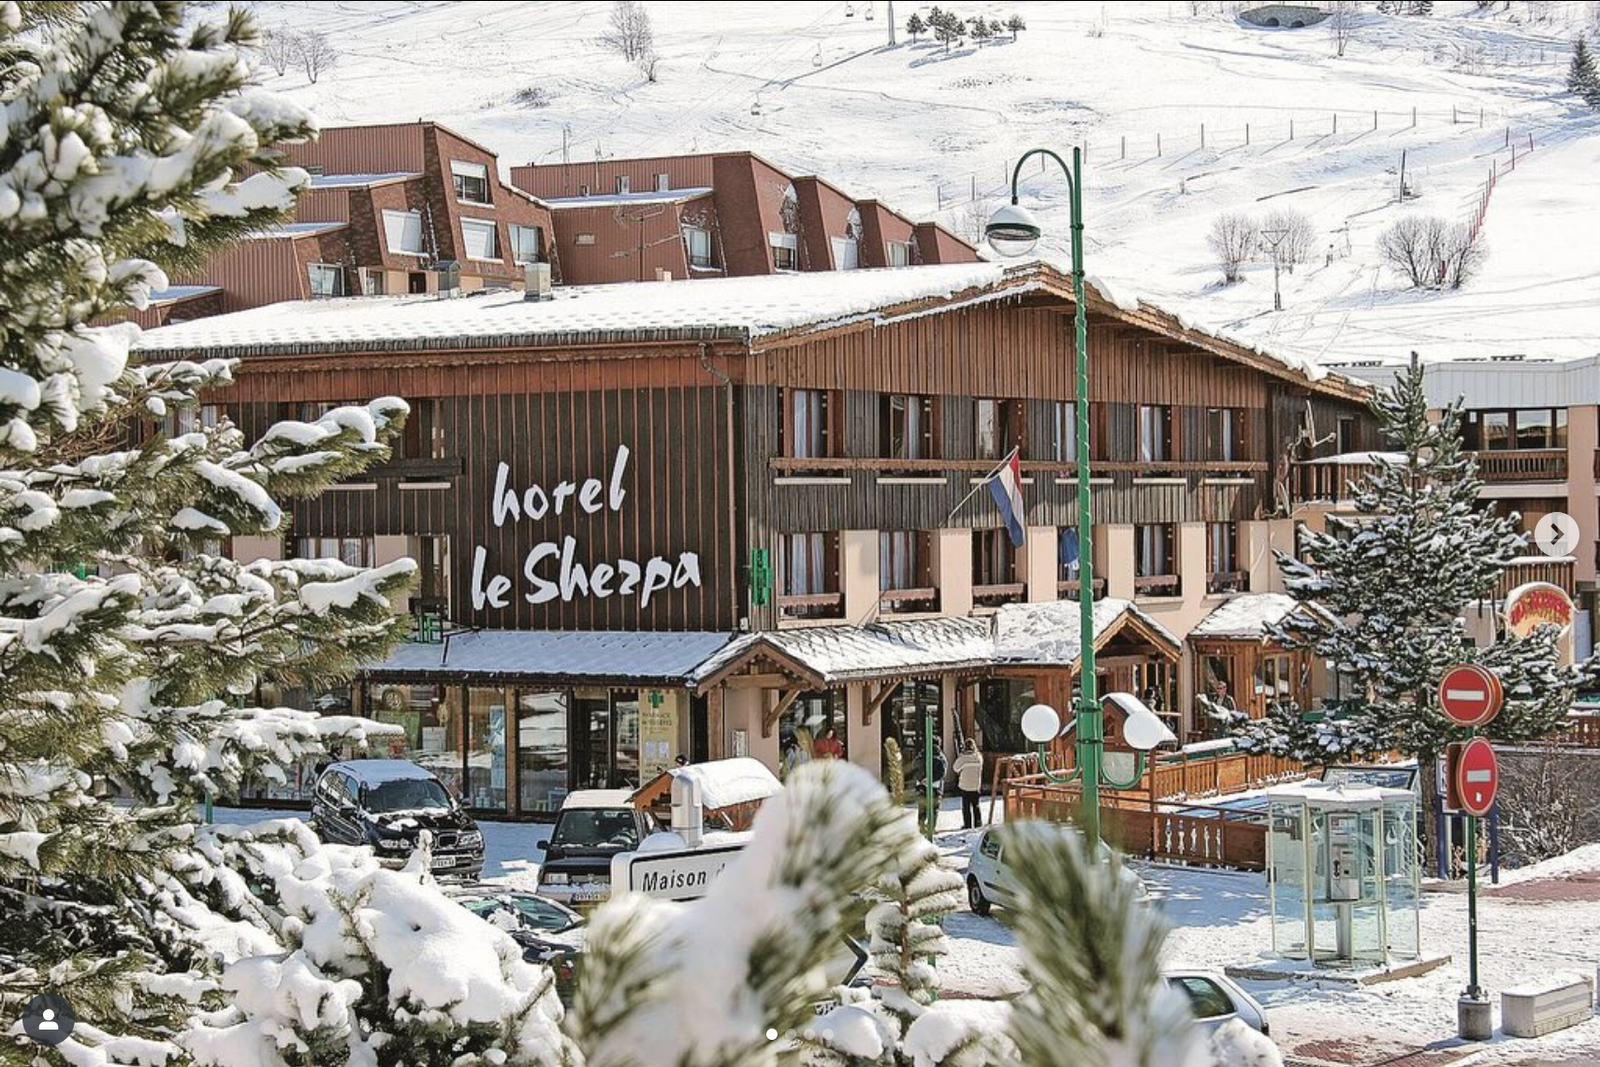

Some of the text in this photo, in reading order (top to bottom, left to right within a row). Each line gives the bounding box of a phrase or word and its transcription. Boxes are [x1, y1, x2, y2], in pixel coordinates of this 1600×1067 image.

[493, 444, 629, 527] hotel
[472, 535, 701, 610] le Sherpa
[642, 869, 707, 892] Maison
